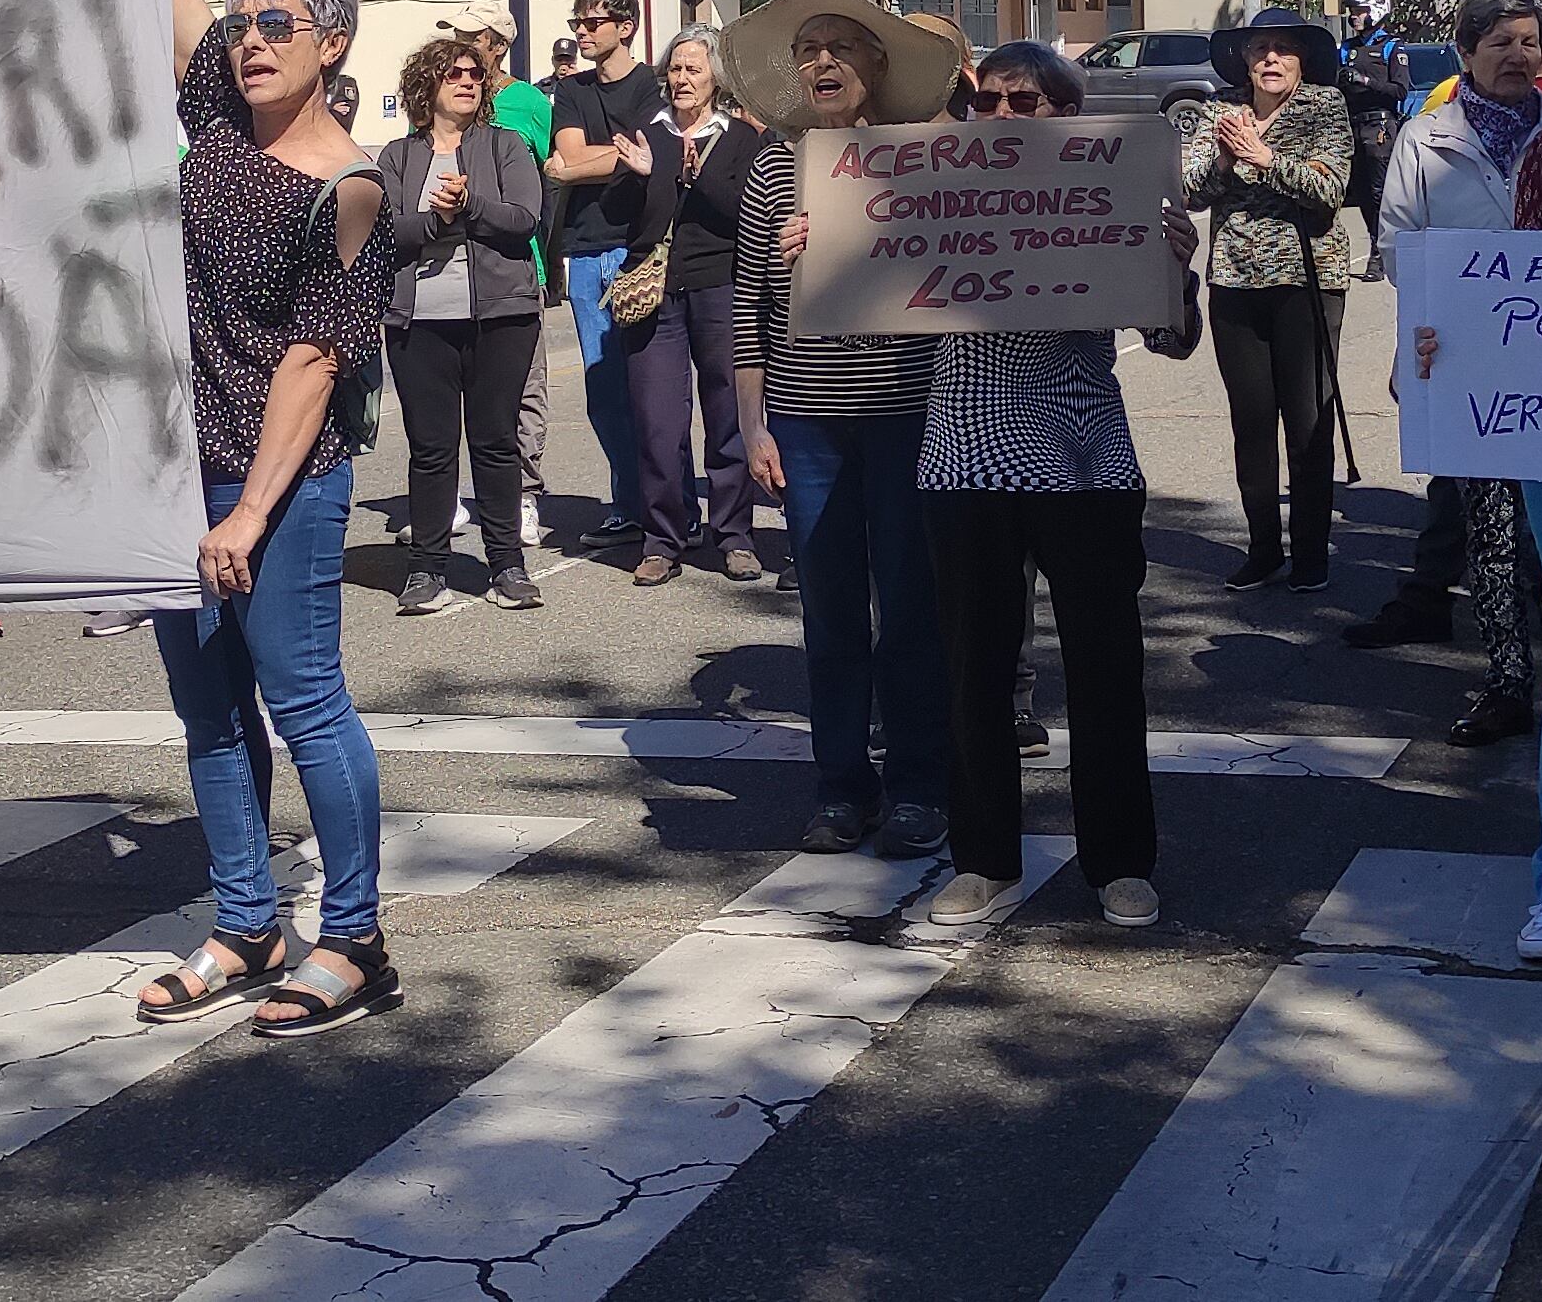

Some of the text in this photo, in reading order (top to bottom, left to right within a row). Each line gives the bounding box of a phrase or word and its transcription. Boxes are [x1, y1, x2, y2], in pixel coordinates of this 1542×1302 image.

[385, 96, 395, 110] P
[830, 135, 1122, 180] ACERAS EN
[865, 187, 1113, 222] CONDICIONES
[869, 225, 1150, 259] NO NOS TOQUES
[1459, 251, 1511, 282] LA
